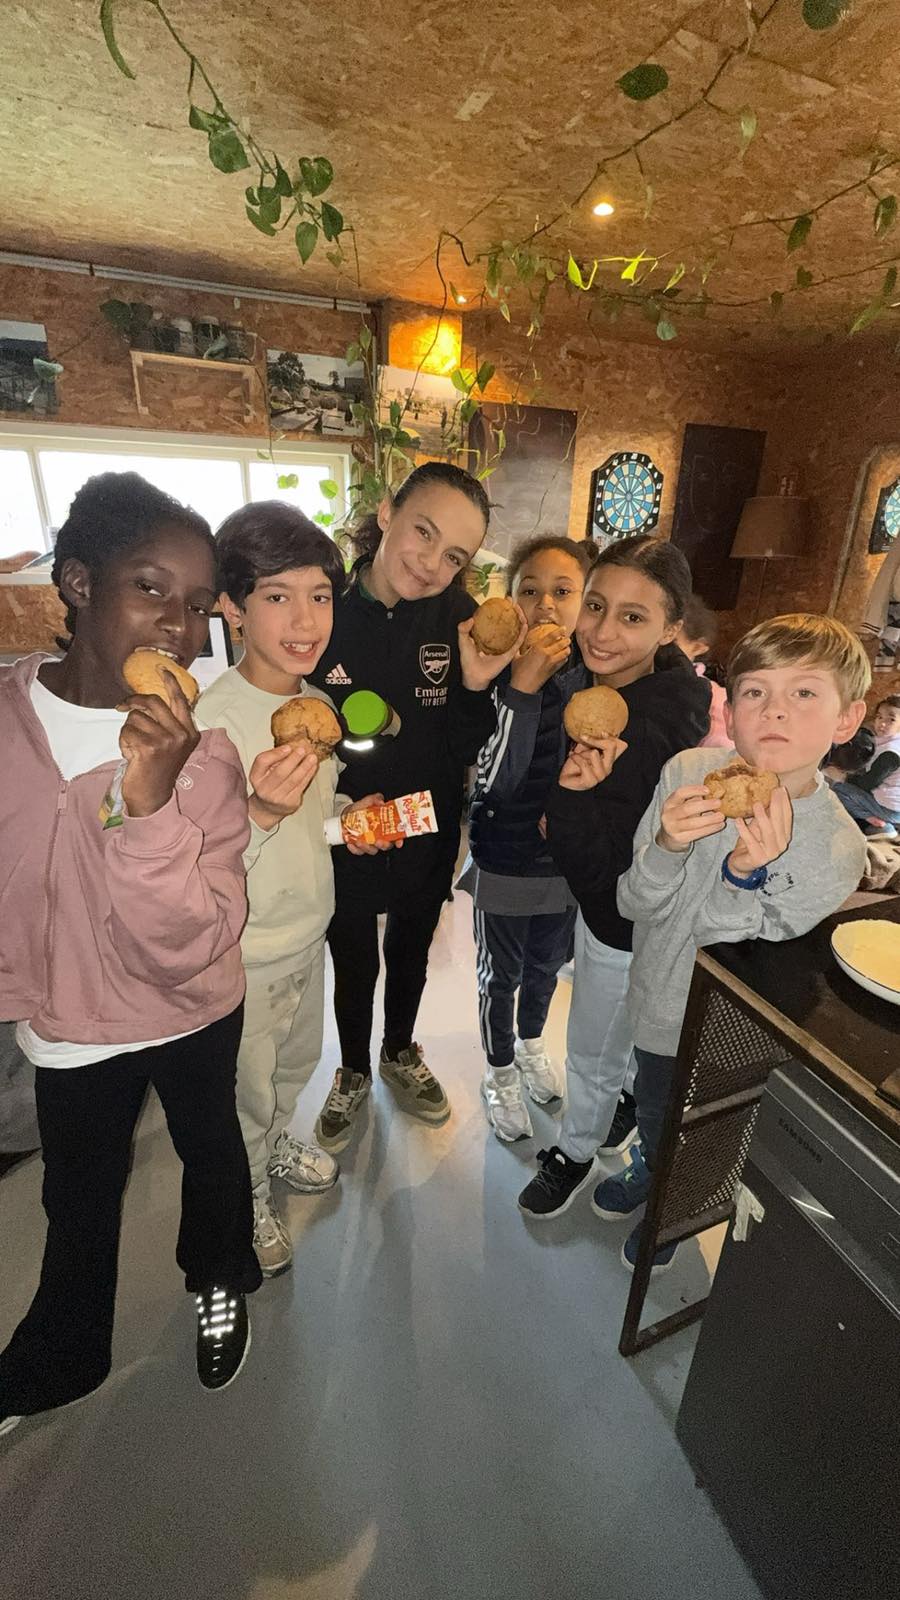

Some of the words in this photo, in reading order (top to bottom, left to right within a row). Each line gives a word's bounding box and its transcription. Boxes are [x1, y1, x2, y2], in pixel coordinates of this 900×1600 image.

[325, 677, 352, 685] adidas
[779, 1118, 823, 1164] SAMSUNG
[268, 1165, 290, 1178] N
